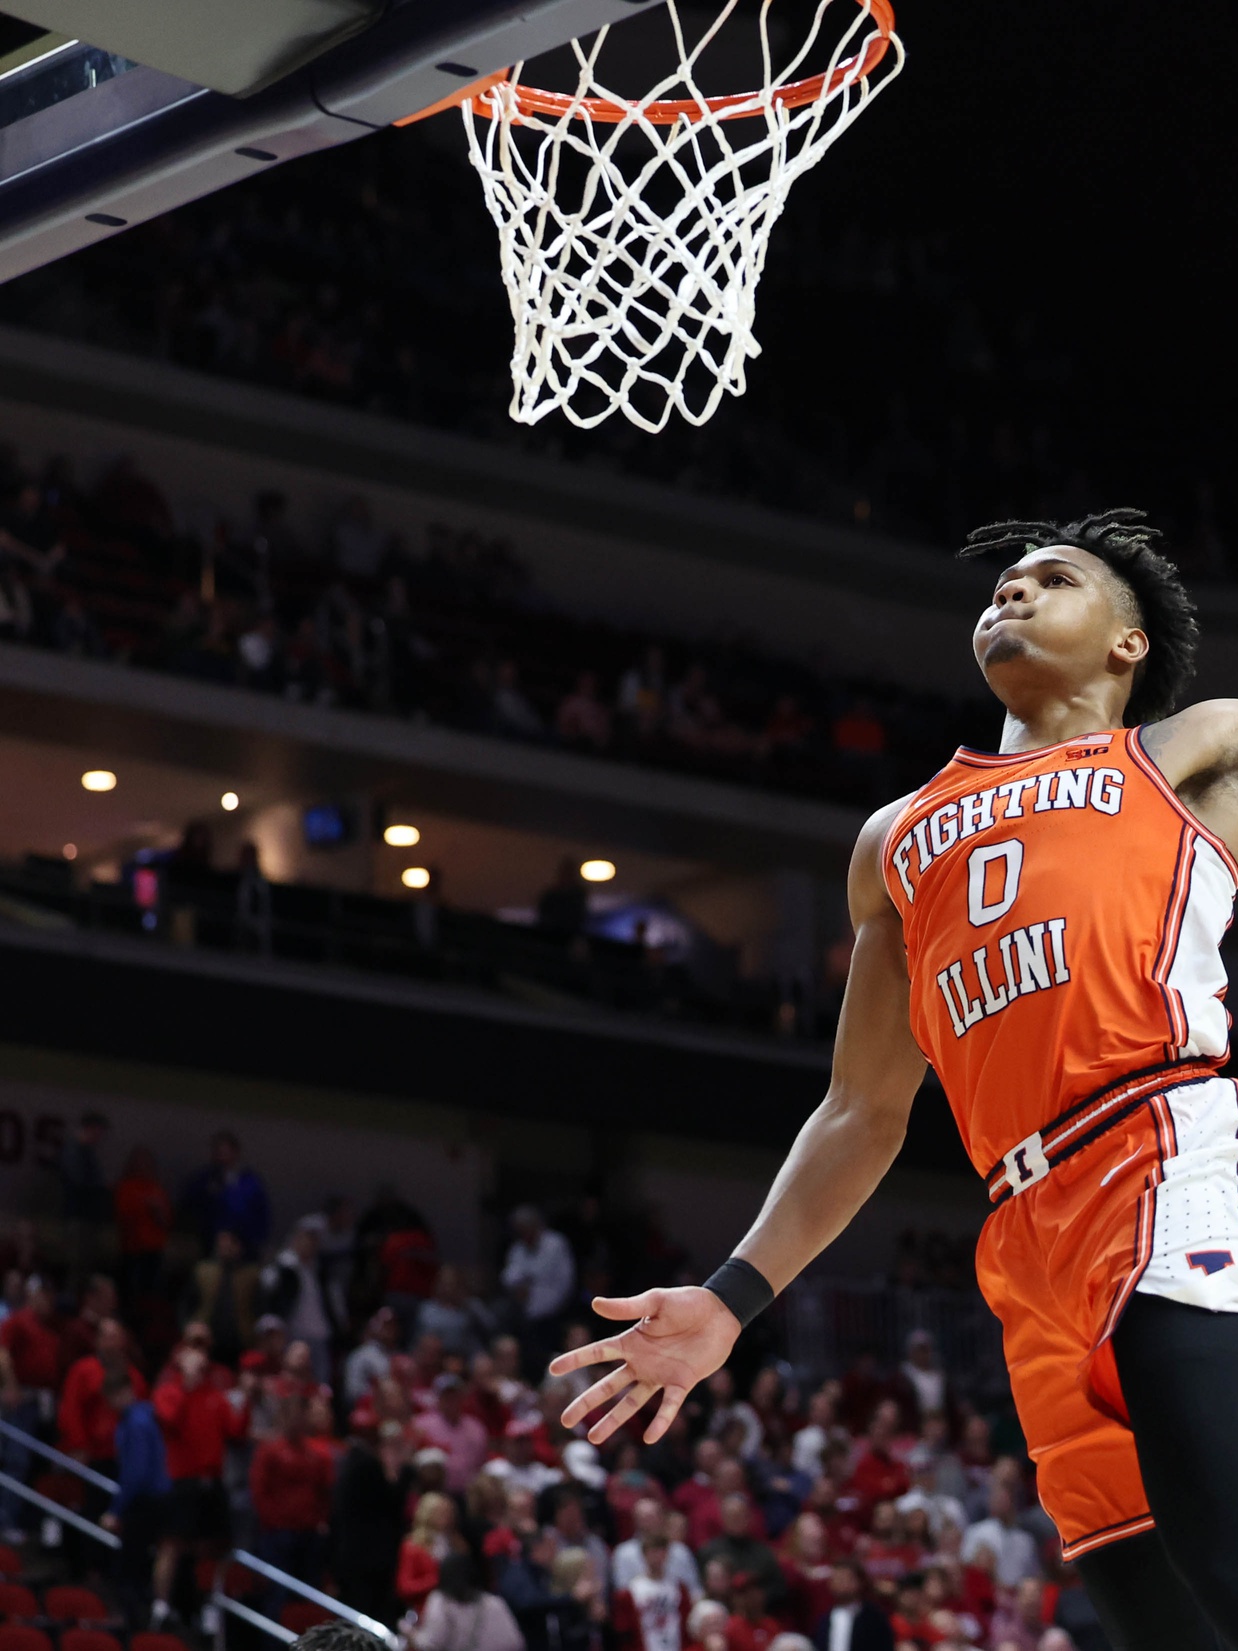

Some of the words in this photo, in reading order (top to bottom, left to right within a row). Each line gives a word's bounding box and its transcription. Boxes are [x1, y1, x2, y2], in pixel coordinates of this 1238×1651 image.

[892, 767, 1125, 905] FIGHTING
[967, 838, 1025, 927] 0
[936, 917, 1071, 1038] ILLINI
